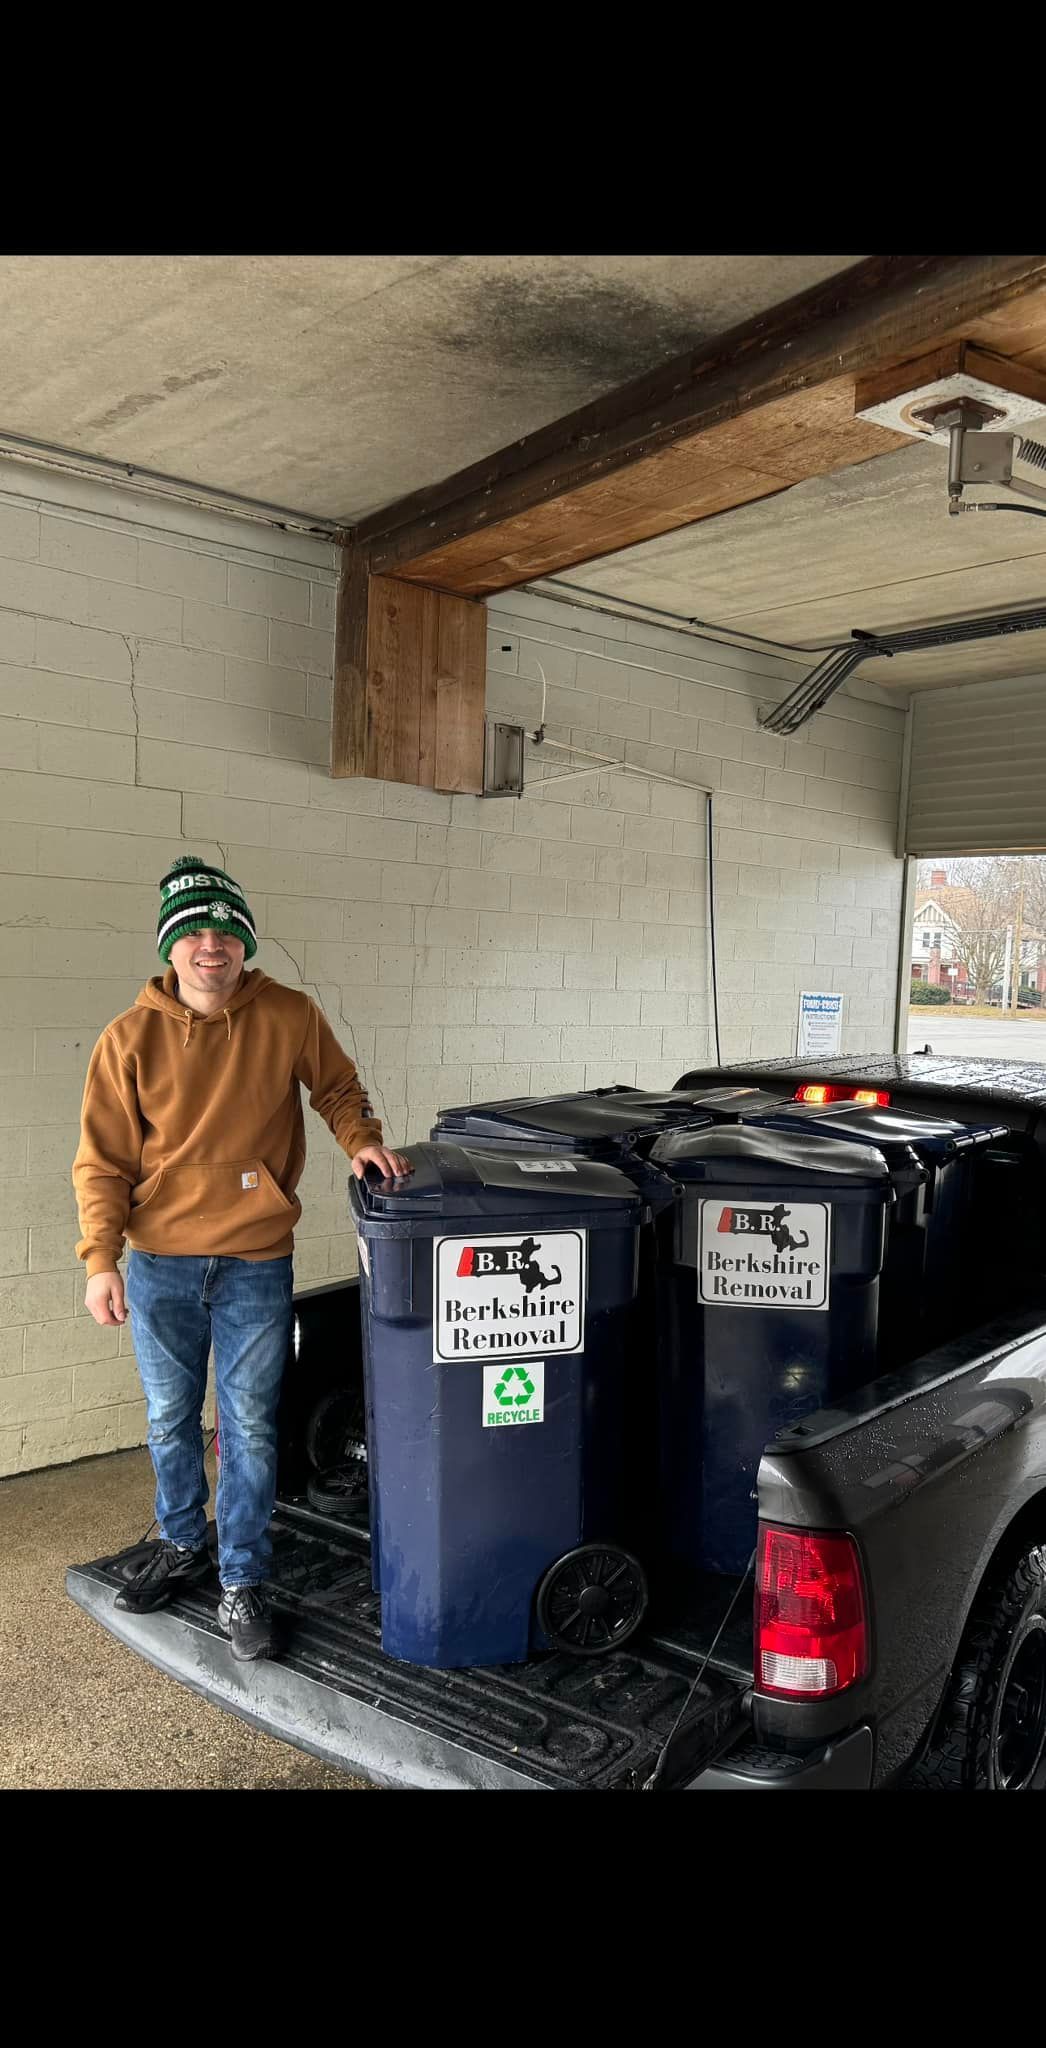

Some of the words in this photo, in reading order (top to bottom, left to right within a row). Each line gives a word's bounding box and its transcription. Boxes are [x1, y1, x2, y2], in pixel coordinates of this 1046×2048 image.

[735, 1213, 755, 1231] B.
[760, 1214, 781, 1231] R.
[476, 1252, 500, 1272] B.
[506, 1251, 530, 1270] R.
[707, 1251, 820, 1275] Berkshire
[713, 1275, 813, 1299] Removal
[445, 1295, 575, 1322] Berkshire
[453, 1320, 567, 1350] Removal
[487, 1408, 540, 1425] RECYCLE
